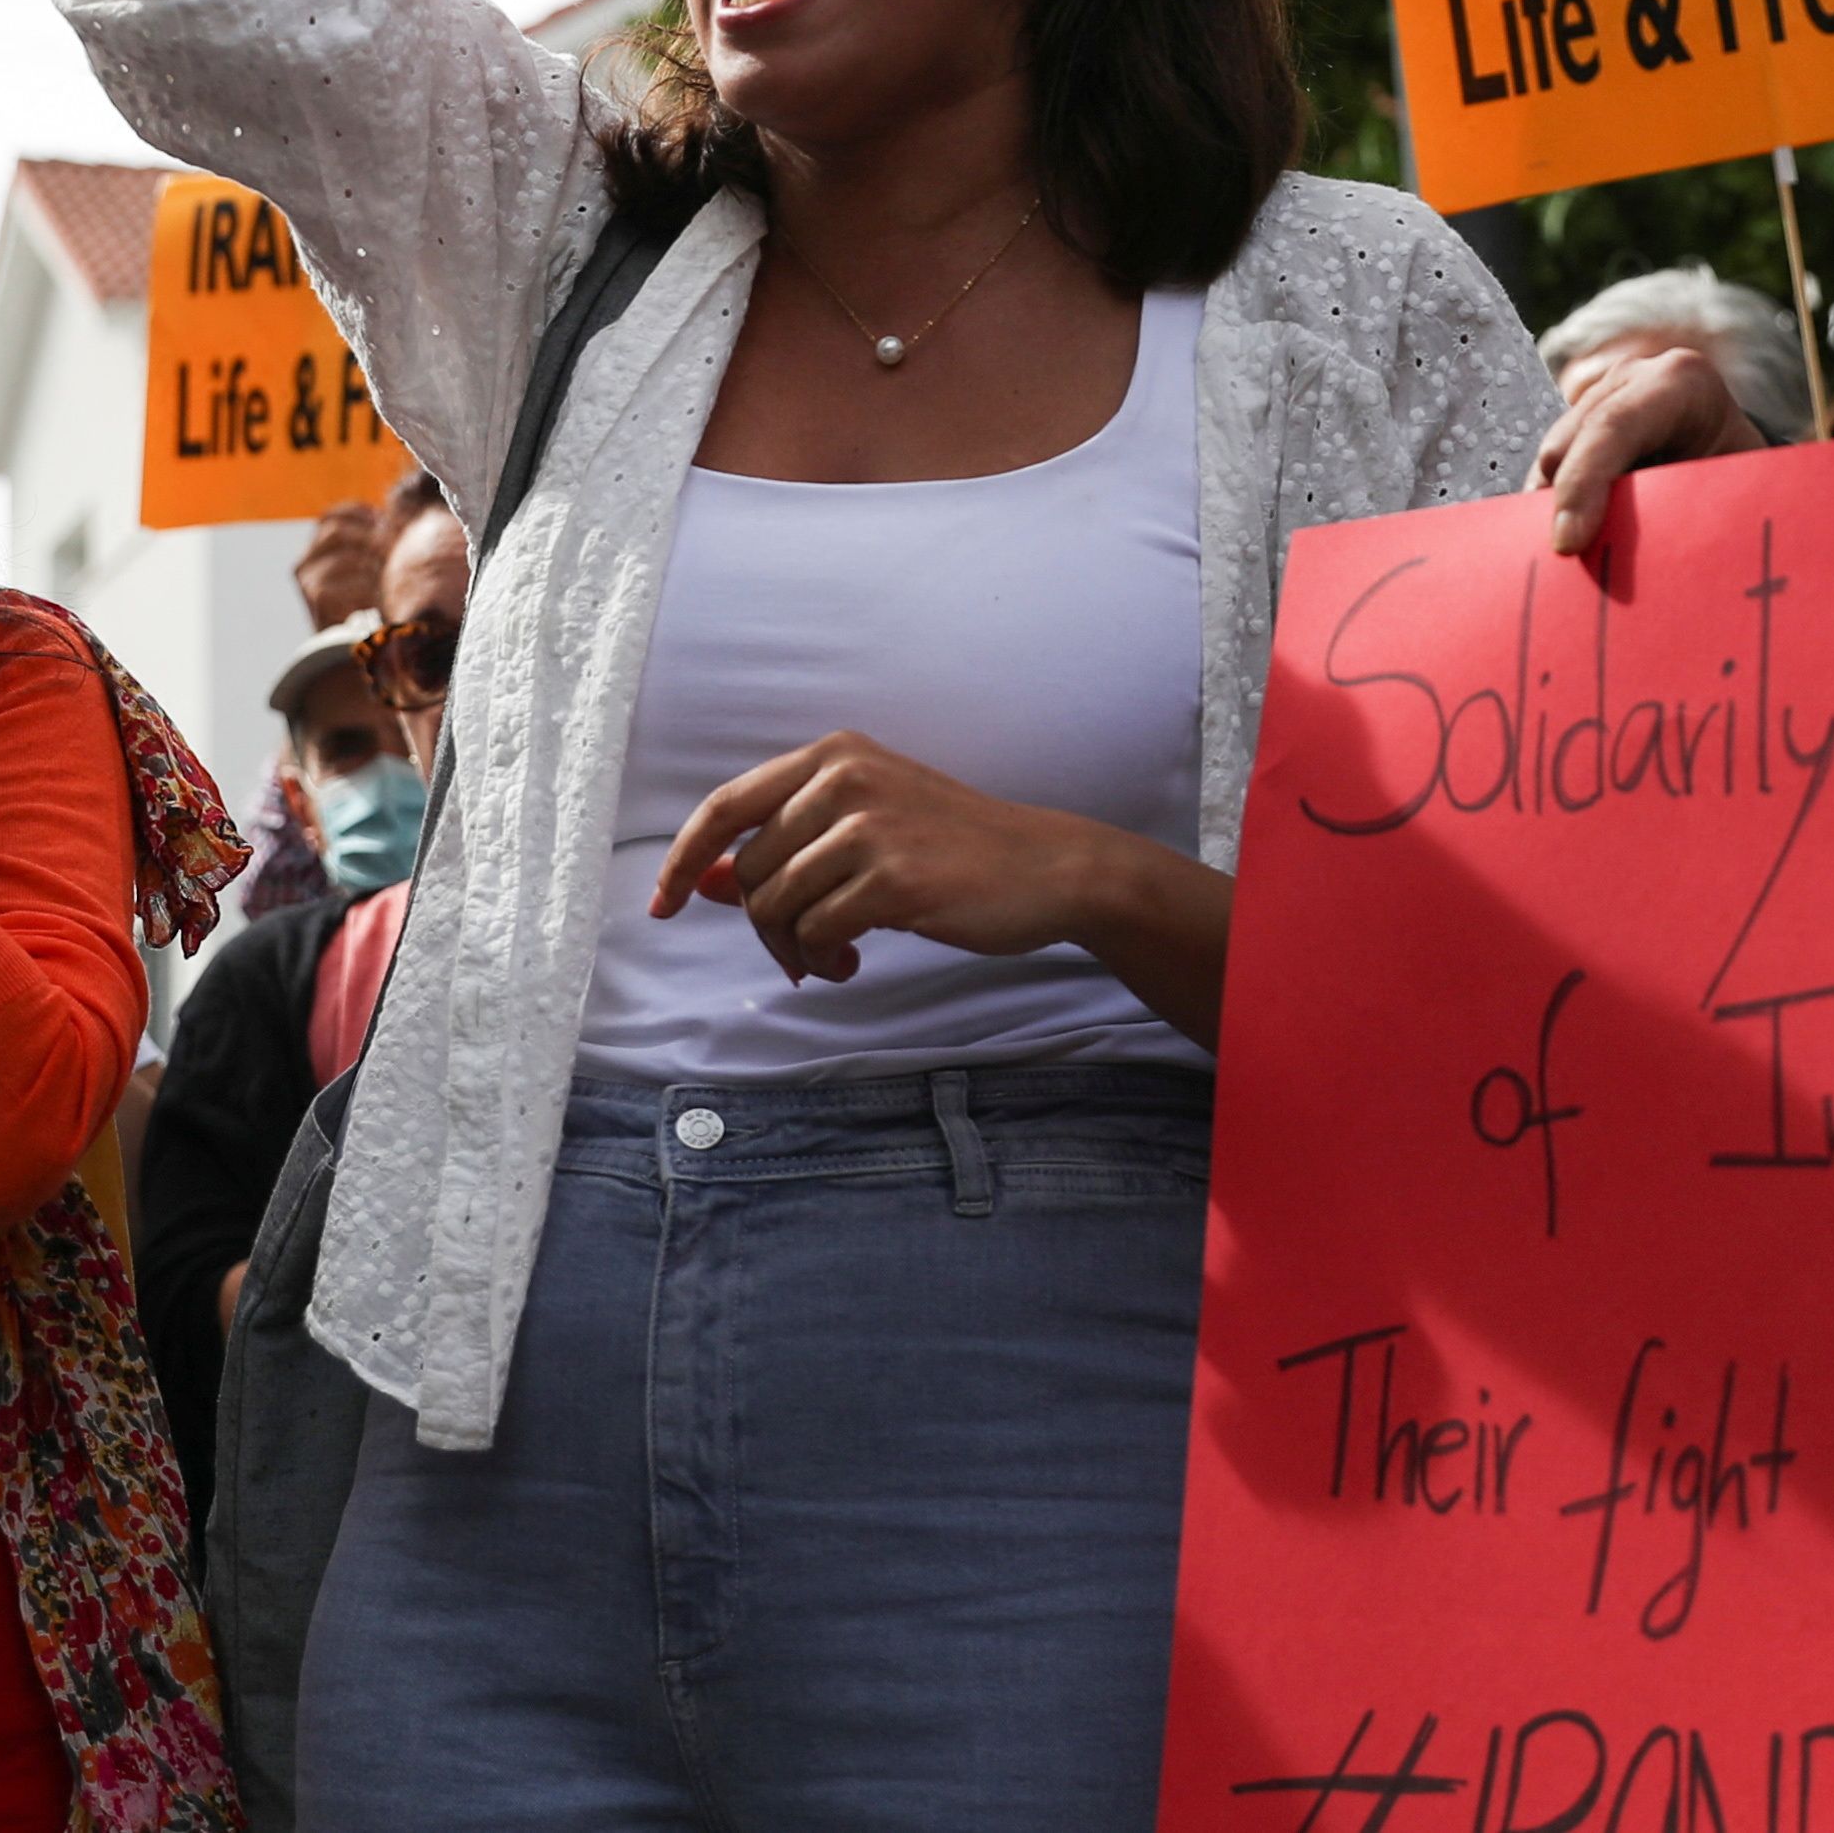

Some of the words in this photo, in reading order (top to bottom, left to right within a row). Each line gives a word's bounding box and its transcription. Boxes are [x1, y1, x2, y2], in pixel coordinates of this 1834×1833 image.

[177, 359, 271, 459] Life
[289, 352, 324, 452] &
[1470, 970, 1586, 1238] of
[1278, 1325, 1533, 1515] Their
[1560, 1336, 1797, 1640] fight
